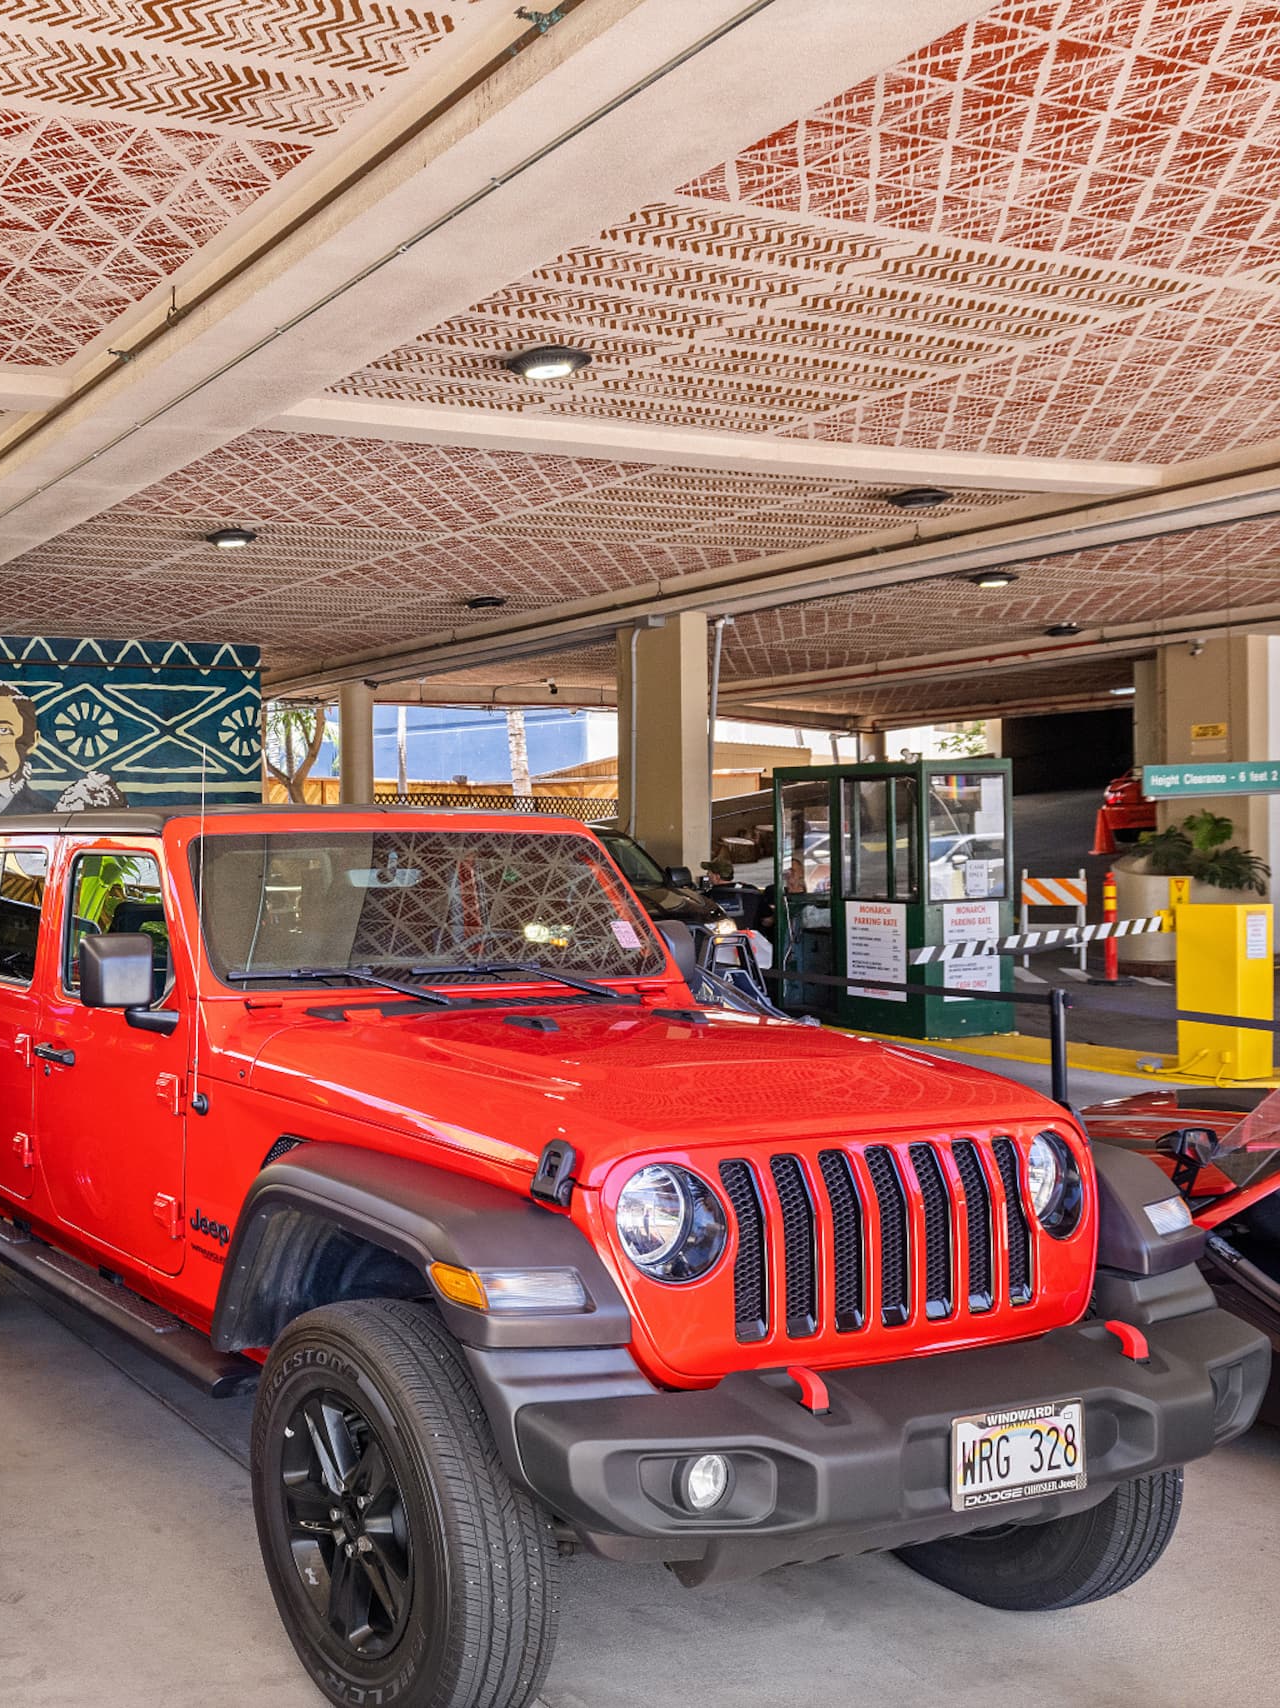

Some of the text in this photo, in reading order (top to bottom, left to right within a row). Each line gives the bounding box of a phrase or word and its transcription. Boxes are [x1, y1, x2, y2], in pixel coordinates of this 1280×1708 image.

[1151, 774, 1180, 787] Height
[1183, 772, 1227, 785] Clearance
[1249, 770, 1268, 781] feet
[854, 917, 881, 926] PARKING
[190, 1207, 230, 1247] Jeep
[987, 1405, 1052, 1427] WINDWARD
[962, 1424, 1077, 1486] WRG 328
[965, 1487, 1023, 1507] DODGE
[1058, 1479, 1076, 1490] Jeep
